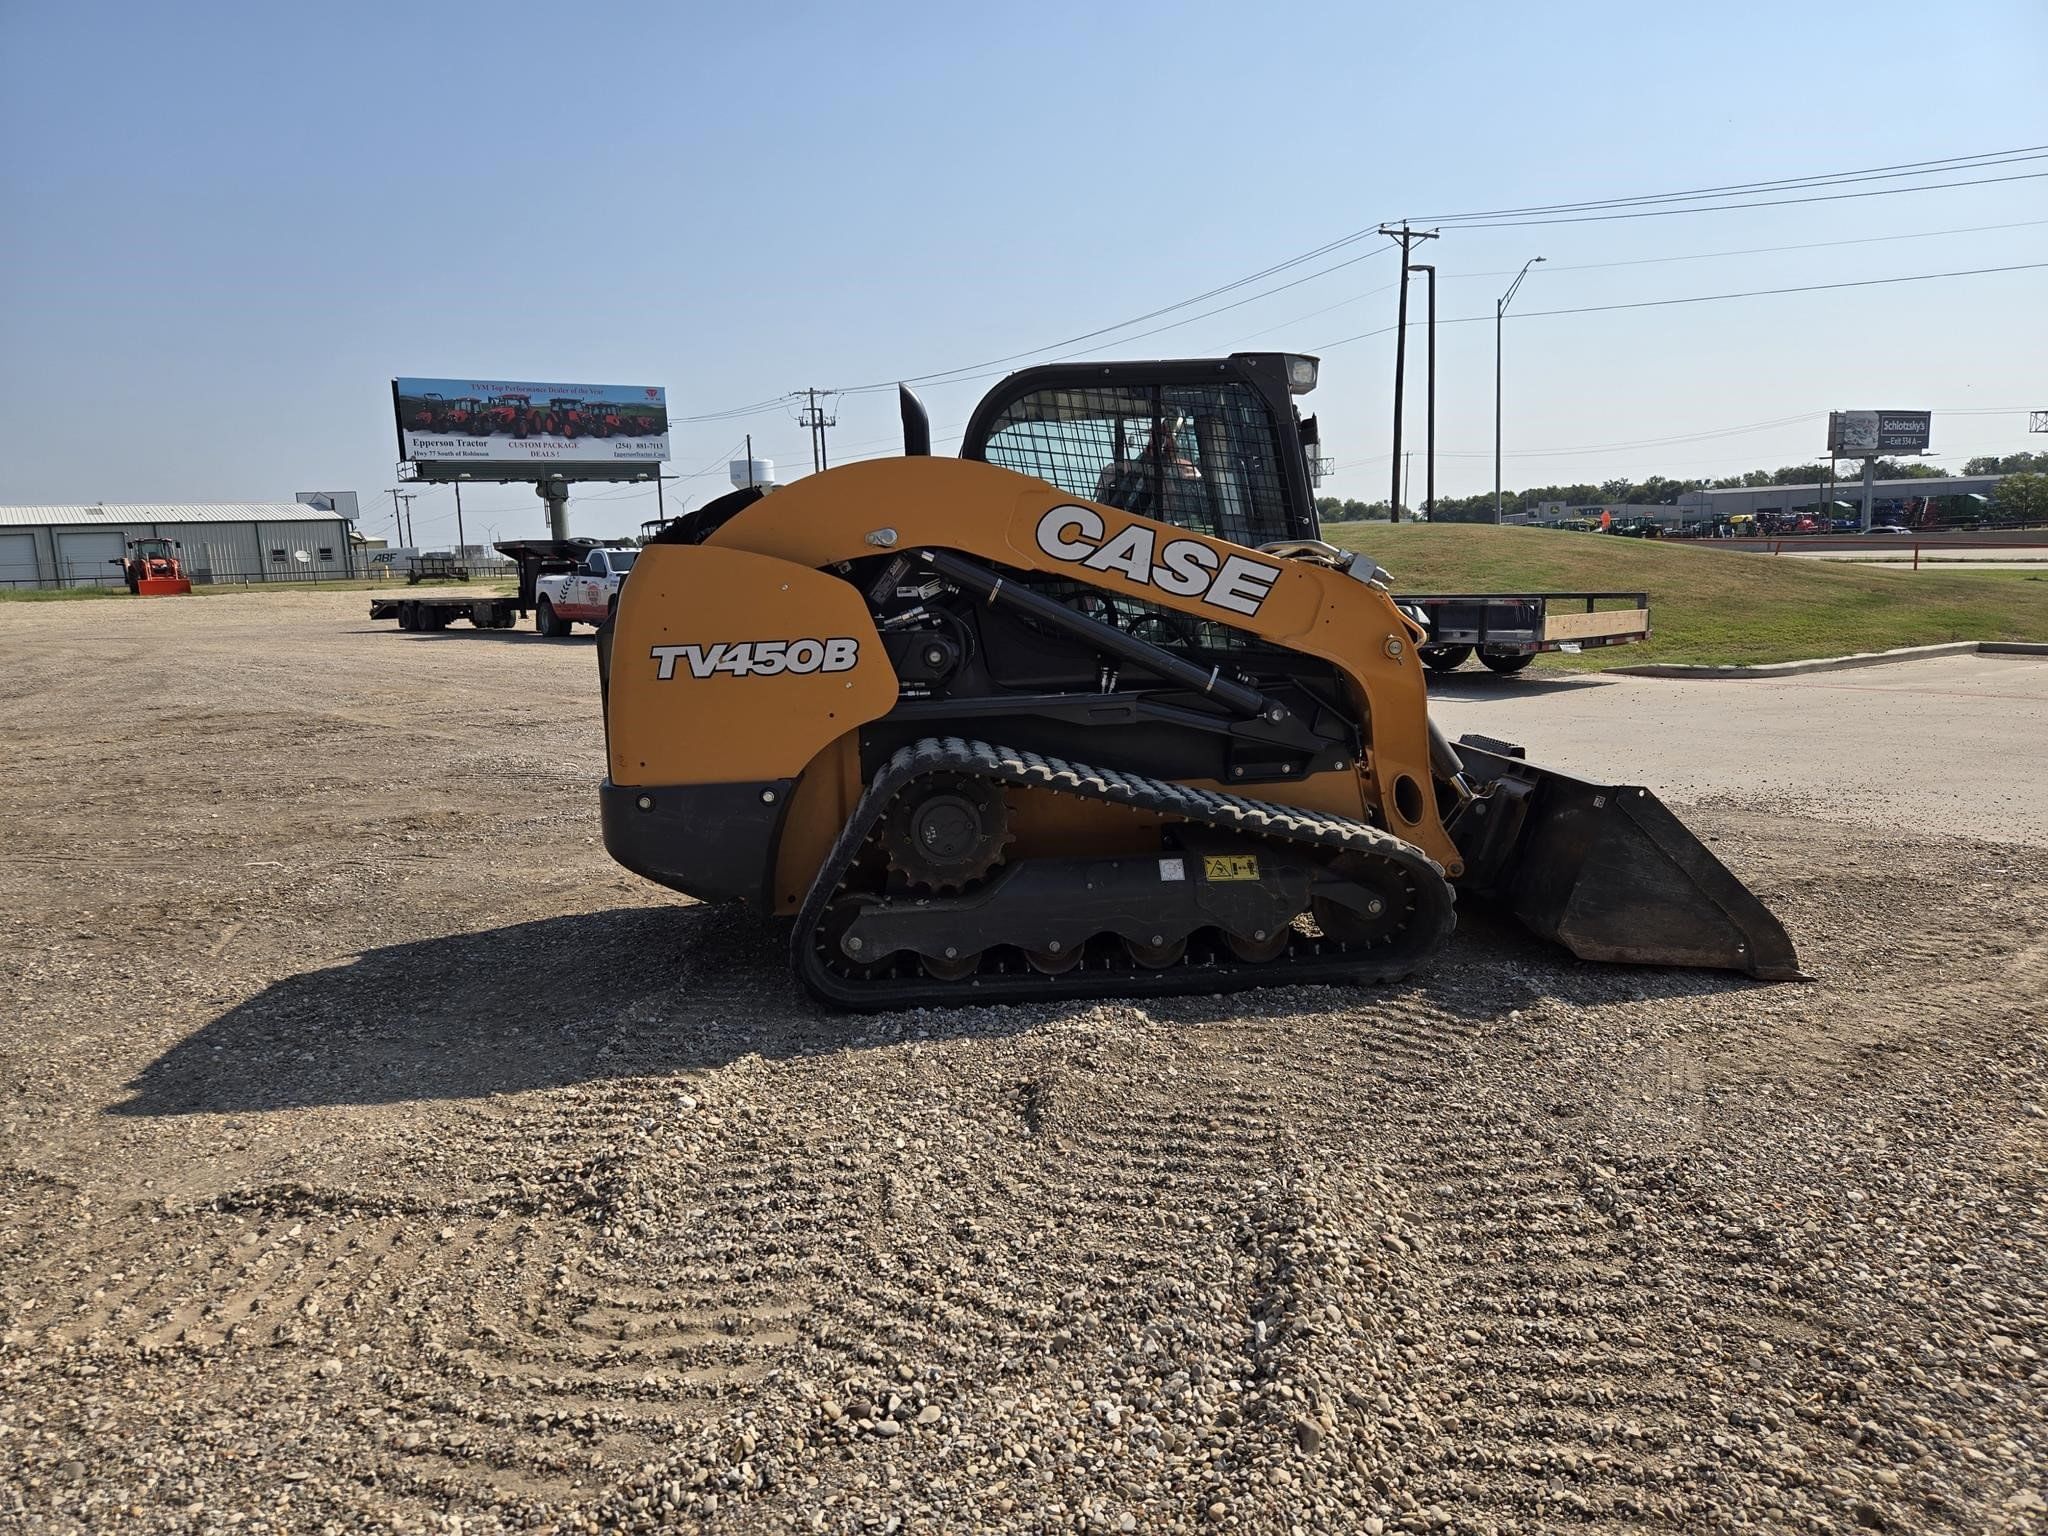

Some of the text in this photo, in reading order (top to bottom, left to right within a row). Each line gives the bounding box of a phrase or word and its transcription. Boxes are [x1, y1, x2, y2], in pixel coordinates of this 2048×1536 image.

[1883, 420, 1925, 432] Schlotzsky's
[413, 438, 488, 448] Epperson Tractor
[508, 441, 579, 449] CUSTOM PACKAGE
[372, 552, 397, 562] ABF
[1035, 503, 1283, 618] CASE
[650, 638, 859, 680] TV450B
